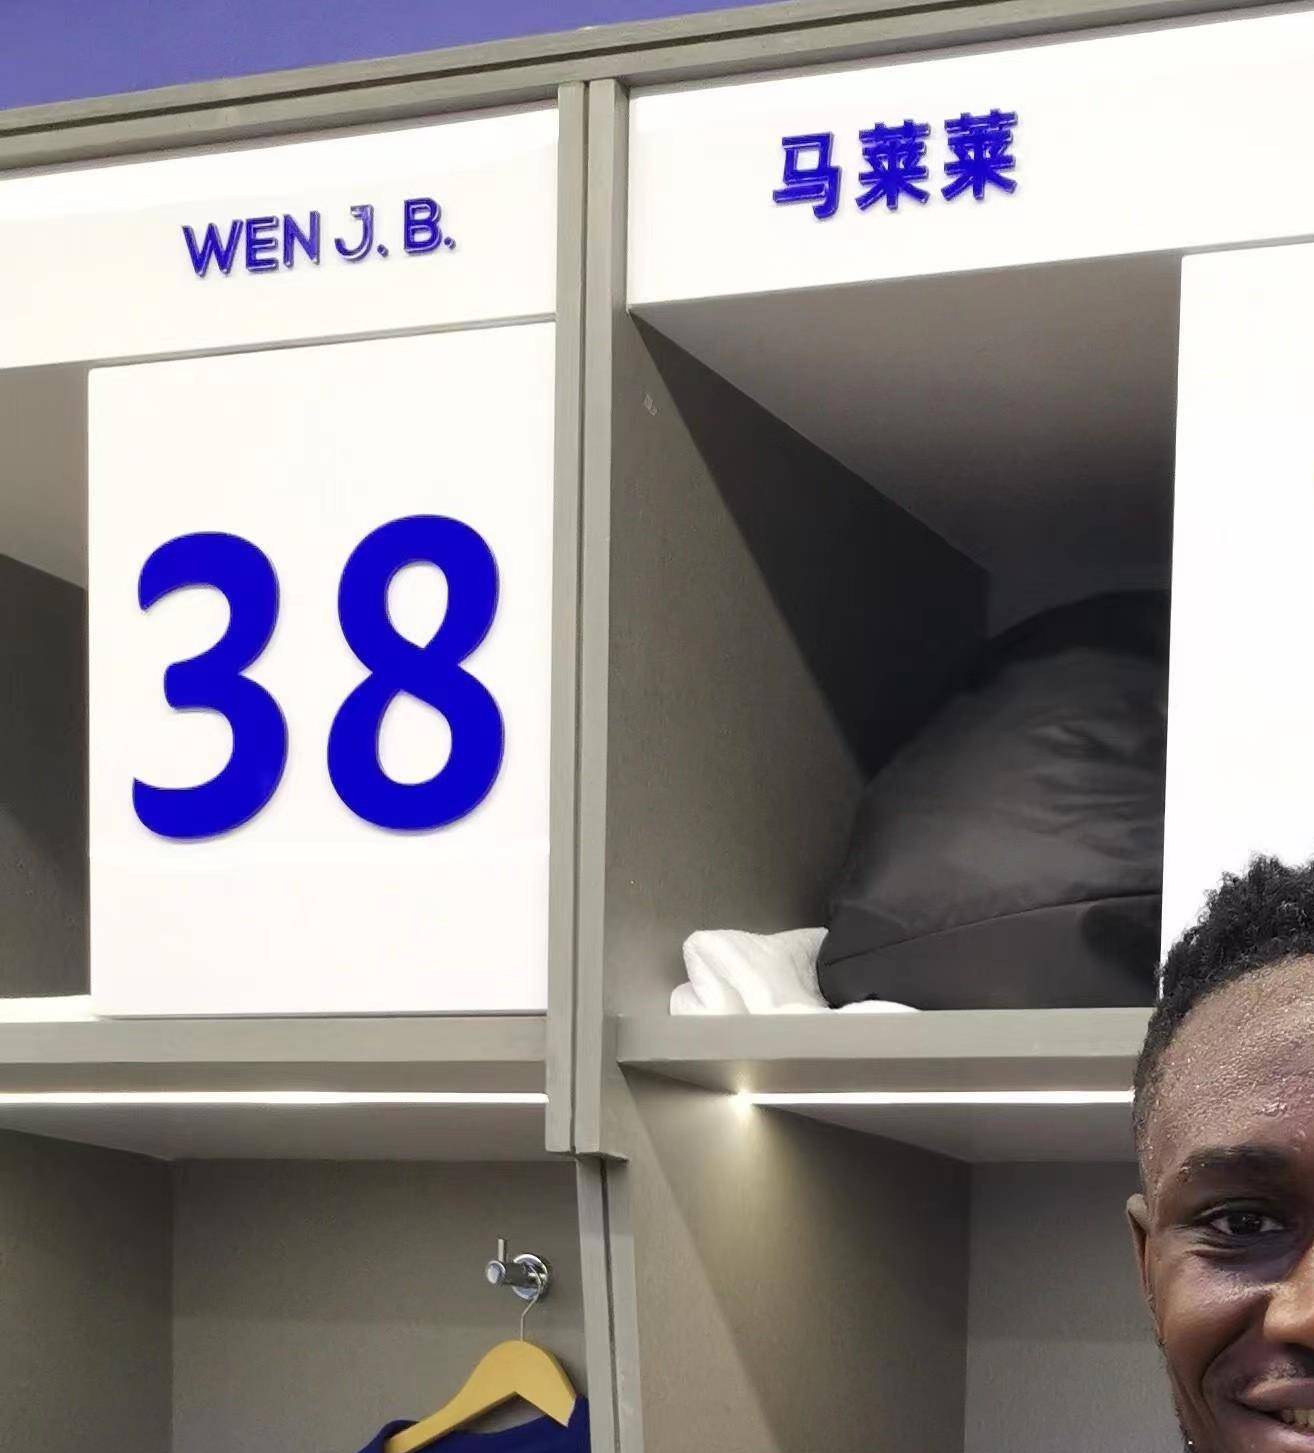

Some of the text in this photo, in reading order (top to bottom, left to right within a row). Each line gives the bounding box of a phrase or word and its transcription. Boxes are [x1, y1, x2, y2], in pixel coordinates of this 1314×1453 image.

[773, 109, 1018, 219] 马莱莱
[182, 197, 456, 277] WEN J. B.
[133, 514, 506, 842] 38
